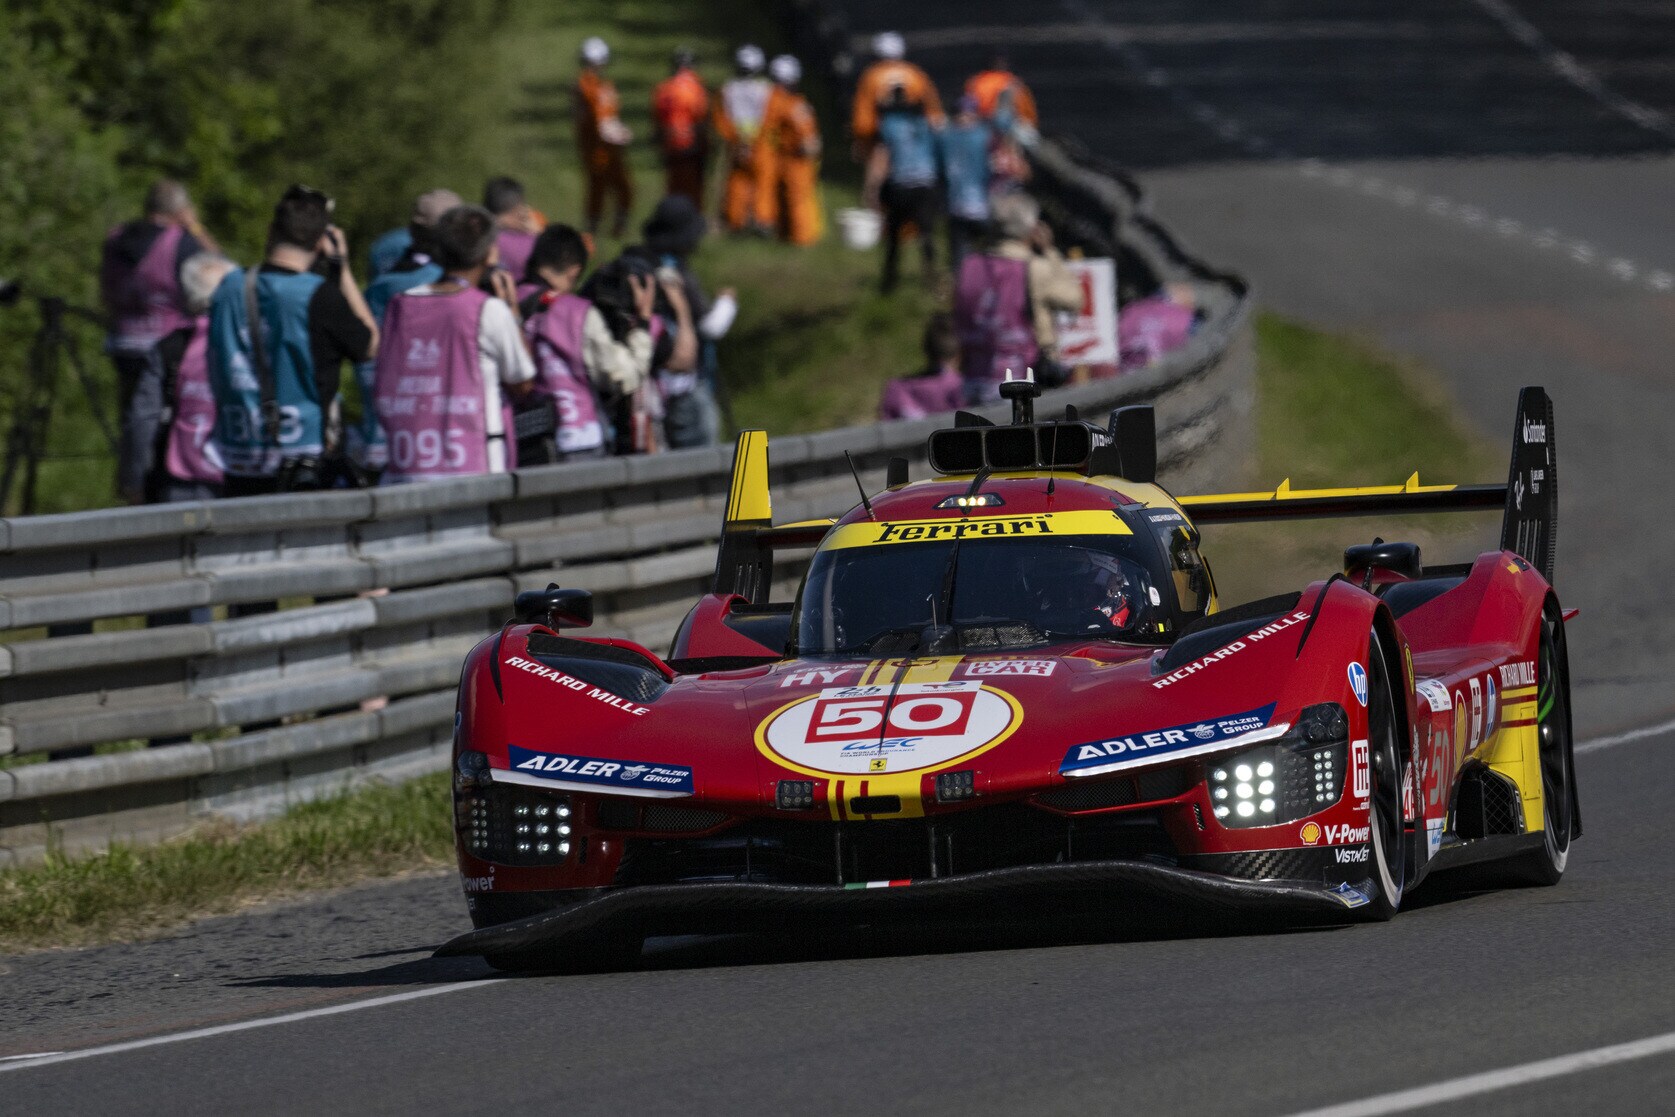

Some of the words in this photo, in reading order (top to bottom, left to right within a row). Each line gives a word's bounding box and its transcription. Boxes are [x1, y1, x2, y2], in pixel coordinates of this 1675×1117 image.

[392, 428, 467, 468] 095
[872, 514, 1053, 543] Ferrari
[1152, 641, 1247, 689] RICHARD
[1246, 611, 1311, 642] MILLE
[781, 669, 853, 688] HY
[970, 665, 1049, 675] CAR
[505, 656, 588, 692] RICHARD
[587, 687, 651, 716] MILLE
[816, 697, 964, 736] 50
[1222, 721, 1264, 735] GROUP
[841, 737, 924, 751] WEC
[1077, 729, 1190, 761] ADLER
[1217, 716, 1261, 728] PELZER
[516, 755, 622, 778] ADLER
[650, 767, 689, 778] PELZER
[643, 773, 682, 785] GROUP
[1324, 823, 1370, 845] V-Power
